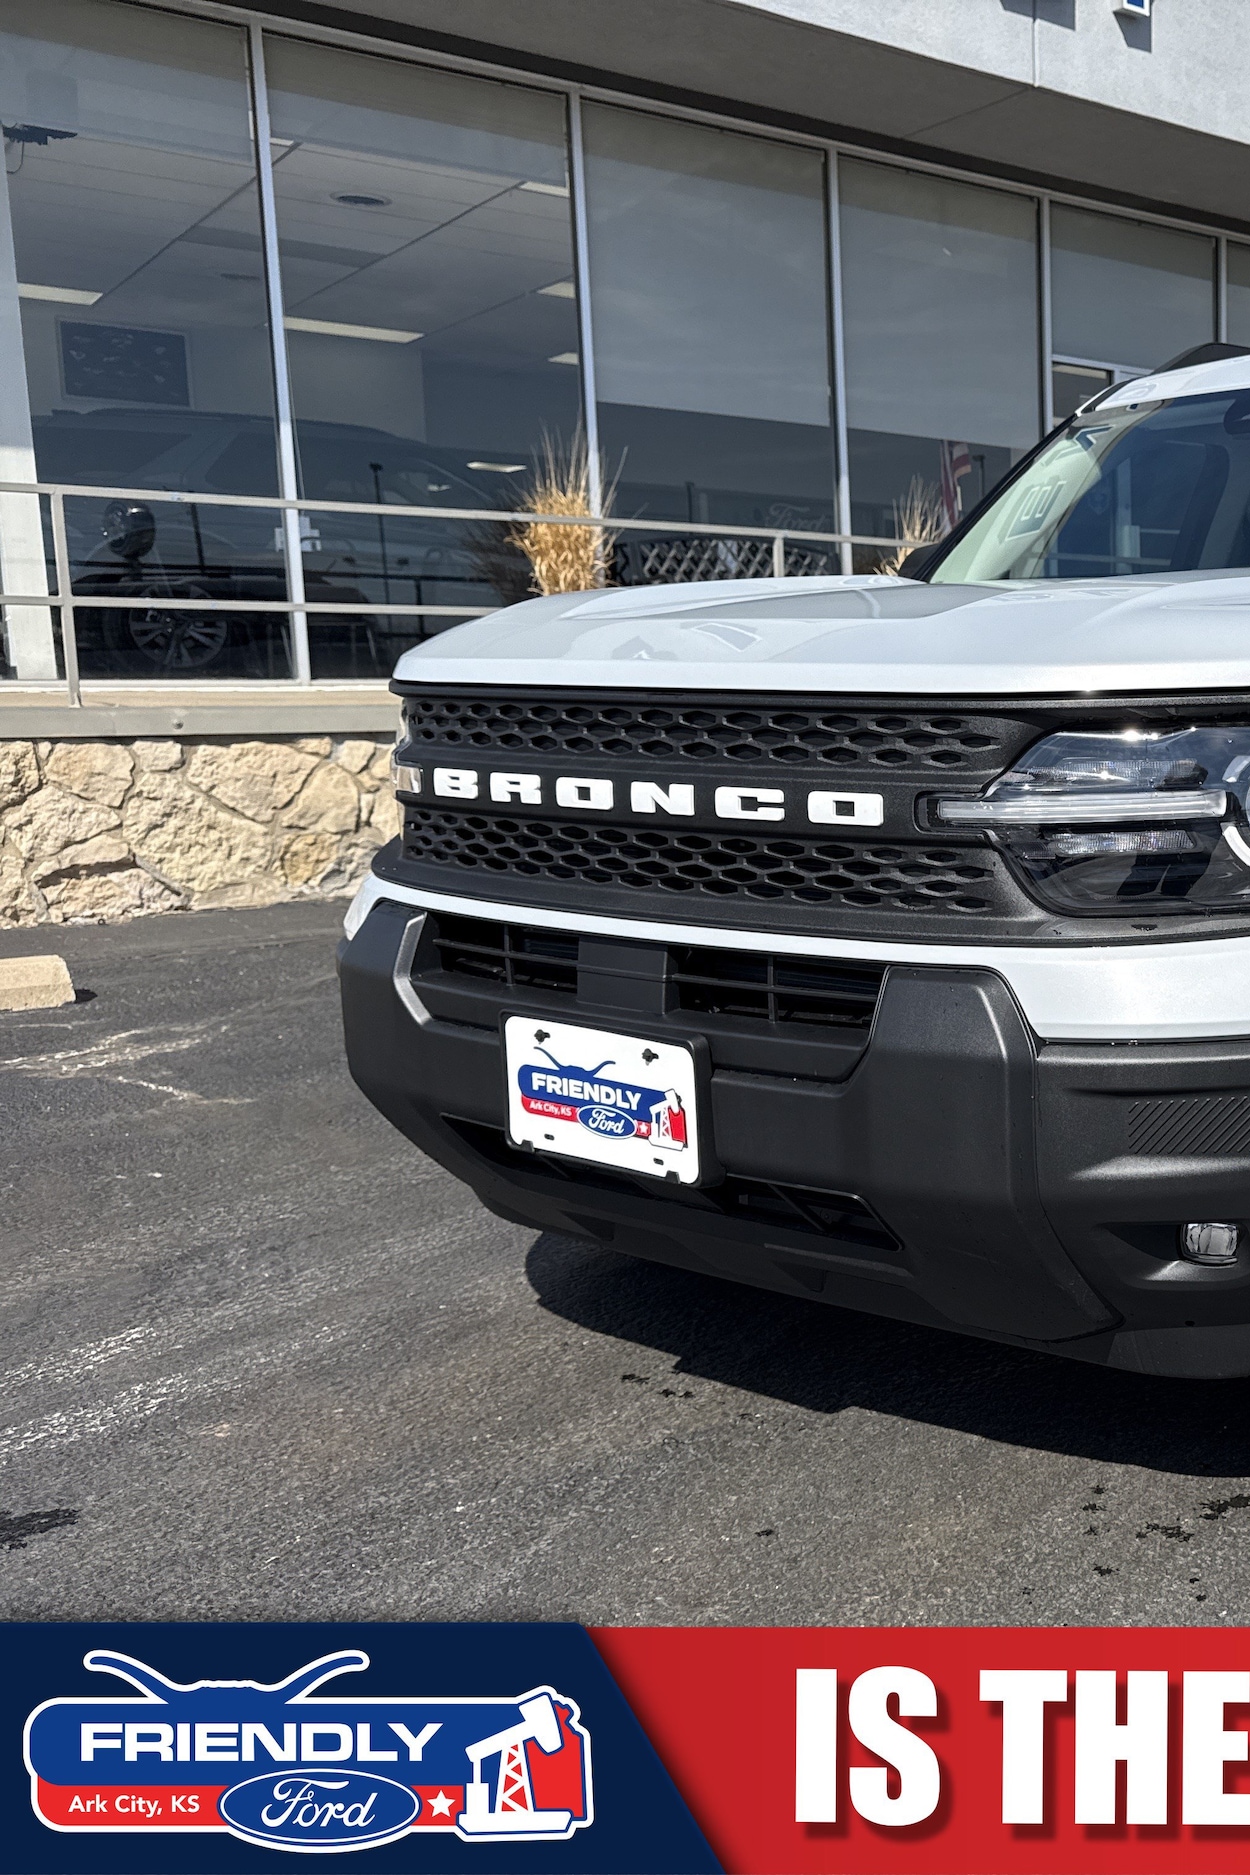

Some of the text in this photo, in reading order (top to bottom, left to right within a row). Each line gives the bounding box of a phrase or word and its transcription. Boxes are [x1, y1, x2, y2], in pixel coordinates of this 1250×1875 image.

[433, 767, 884, 826] BRONCO
[531, 1072, 641, 1110] FRIENDLY
[529, 1101, 543, 1111] Ark
[558, 1107, 572, 1116] KS
[588, 1109, 625, 1133] Ford
